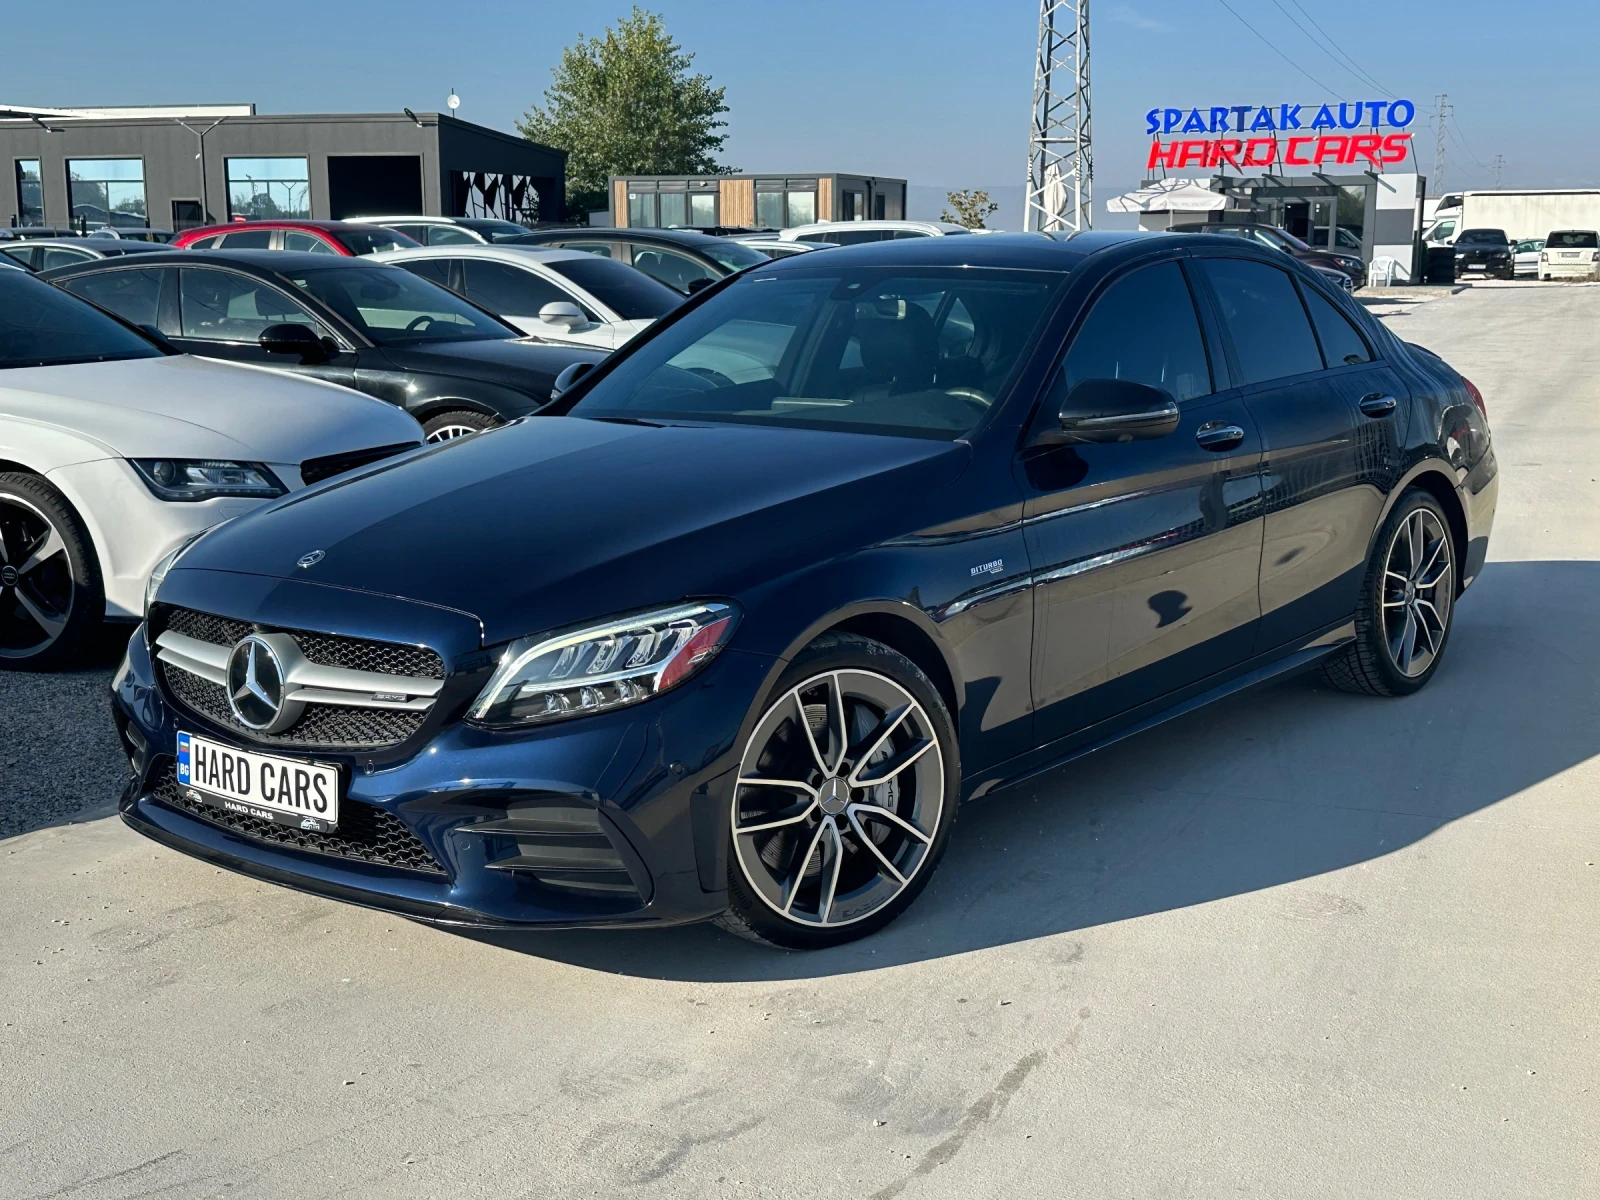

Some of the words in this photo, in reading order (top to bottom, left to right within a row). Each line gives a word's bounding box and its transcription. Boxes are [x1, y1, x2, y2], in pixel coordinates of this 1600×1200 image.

[1146, 103, 1301, 134] SPARTAK
[1310, 99, 1415, 130] AUTO
[1147, 138, 1277, 175] HARD
[1284, 132, 1416, 170] CARS
[970, 559, 1002, 575] BITURBO
[180, 763, 189, 776] BG
[195, 744, 250, 795] HARD
[260, 762, 327, 813] CARS
[225, 802, 249, 813] HARD
[250, 808, 274, 820] CARS
